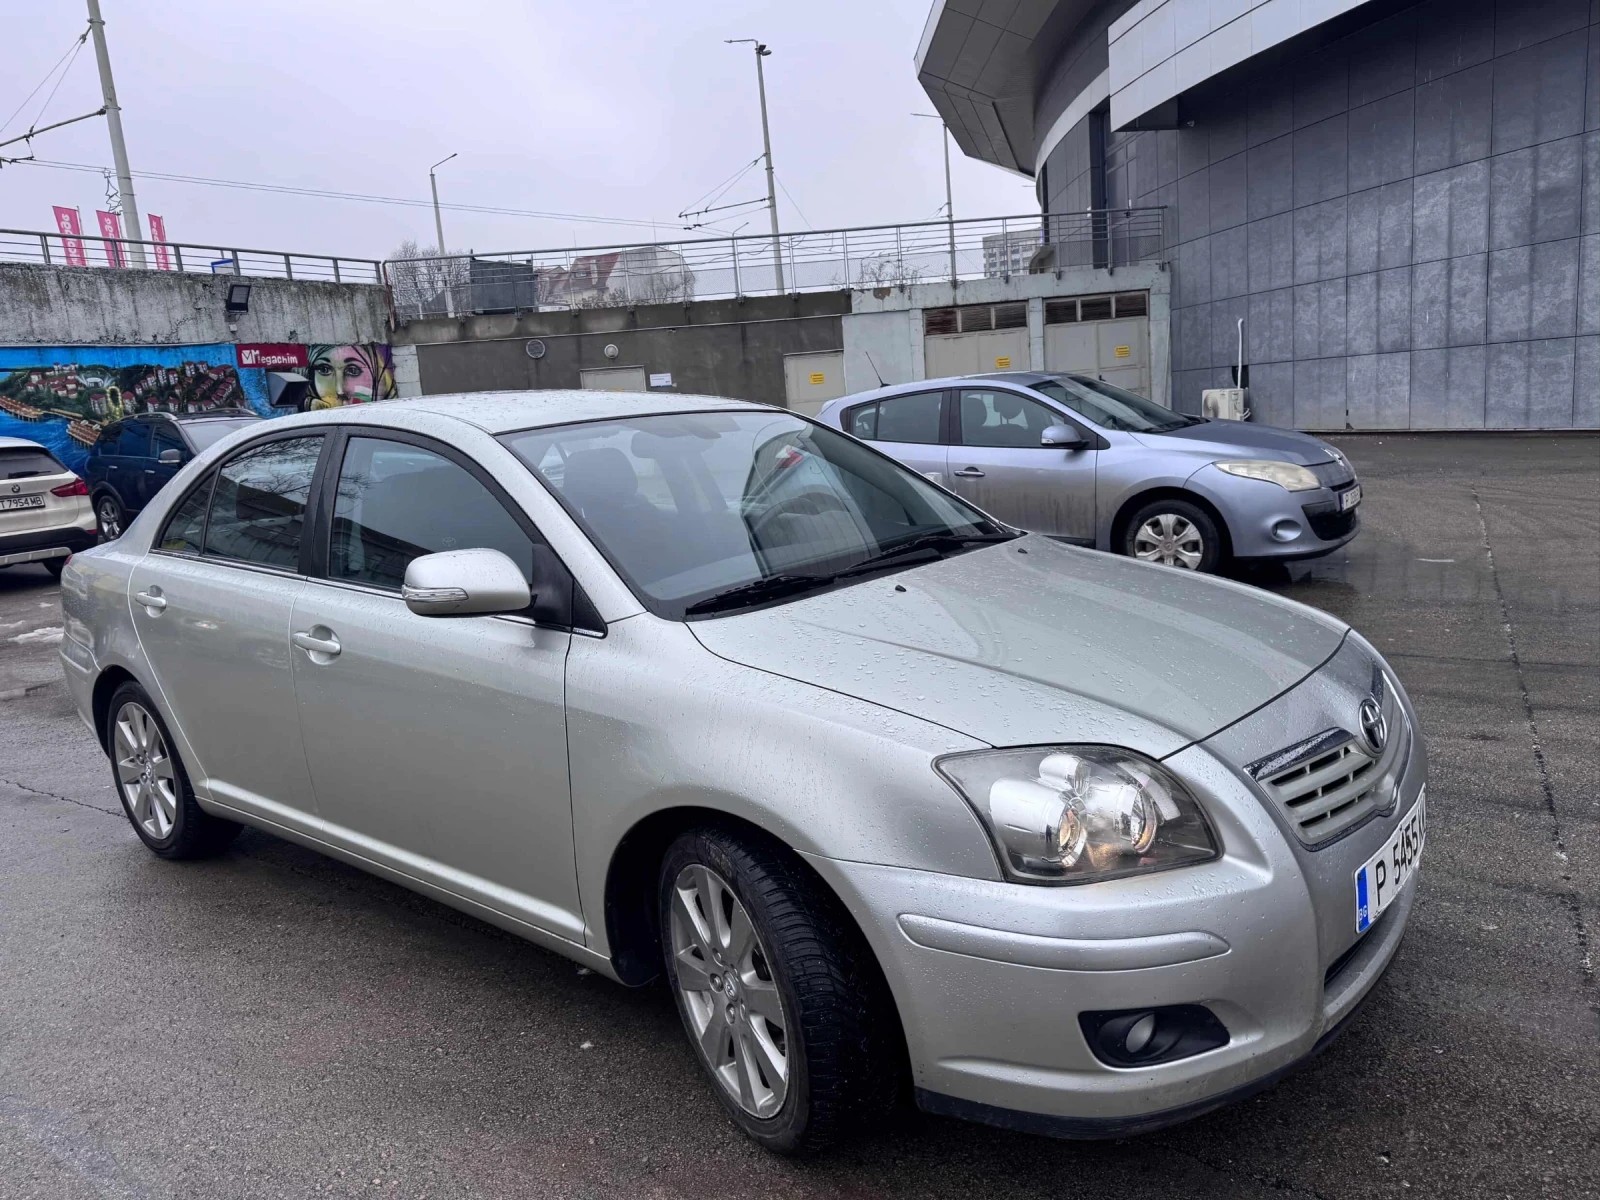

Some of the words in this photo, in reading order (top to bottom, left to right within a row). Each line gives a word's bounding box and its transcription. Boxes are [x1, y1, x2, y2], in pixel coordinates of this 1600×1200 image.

[7, 498, 29, 508] 7954
[31, 497, 42, 505] MB
[1376, 861, 1387, 907] P
[1392, 817, 1417, 884] 5455
[1358, 905, 1367, 921] BG
